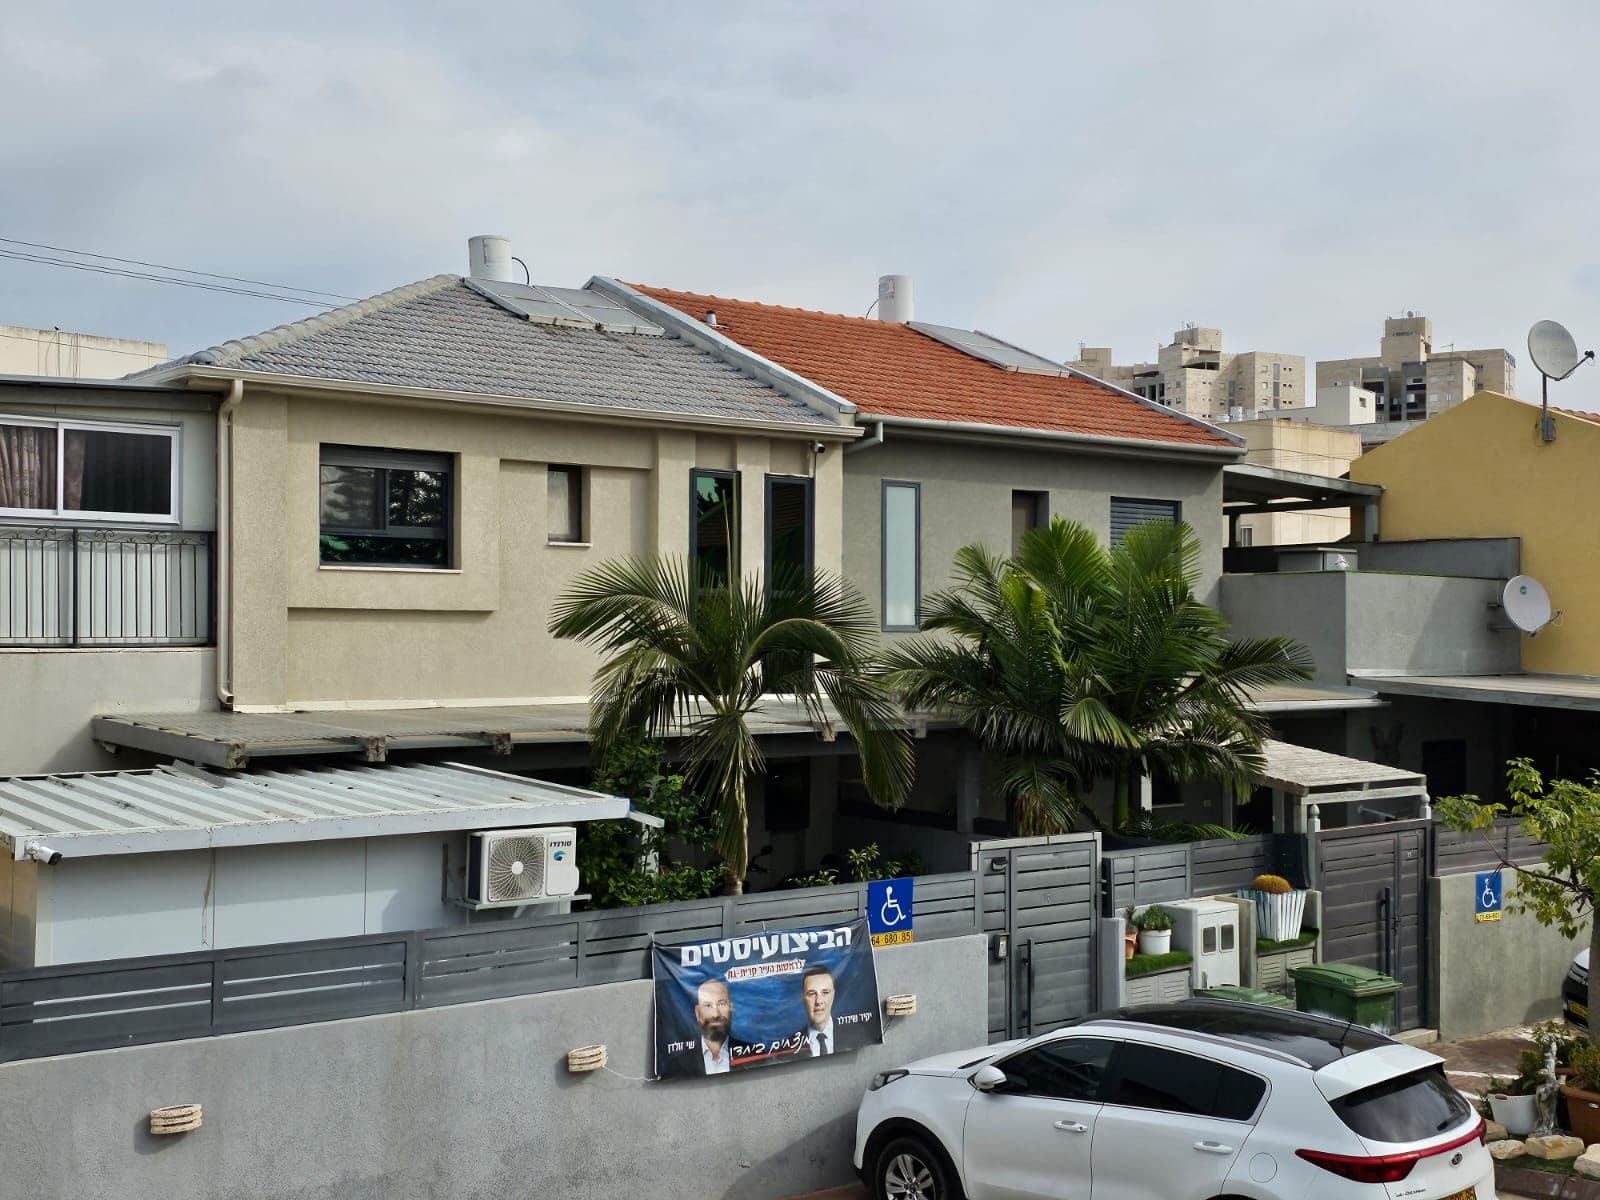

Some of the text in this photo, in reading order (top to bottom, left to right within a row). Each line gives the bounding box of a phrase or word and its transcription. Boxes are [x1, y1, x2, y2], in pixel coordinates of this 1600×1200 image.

[549, 840, 572, 848] טורנדו
[871, 931, 911, 946] 64 680 85
[681, 927, 851, 967] הביצועיסטים
[759, 964, 775, 975] העיר
[776, 960, 802, 973] לראשות
[859, 1011, 873, 1022] יקיר
[686, 1040, 695, 1050] שי
